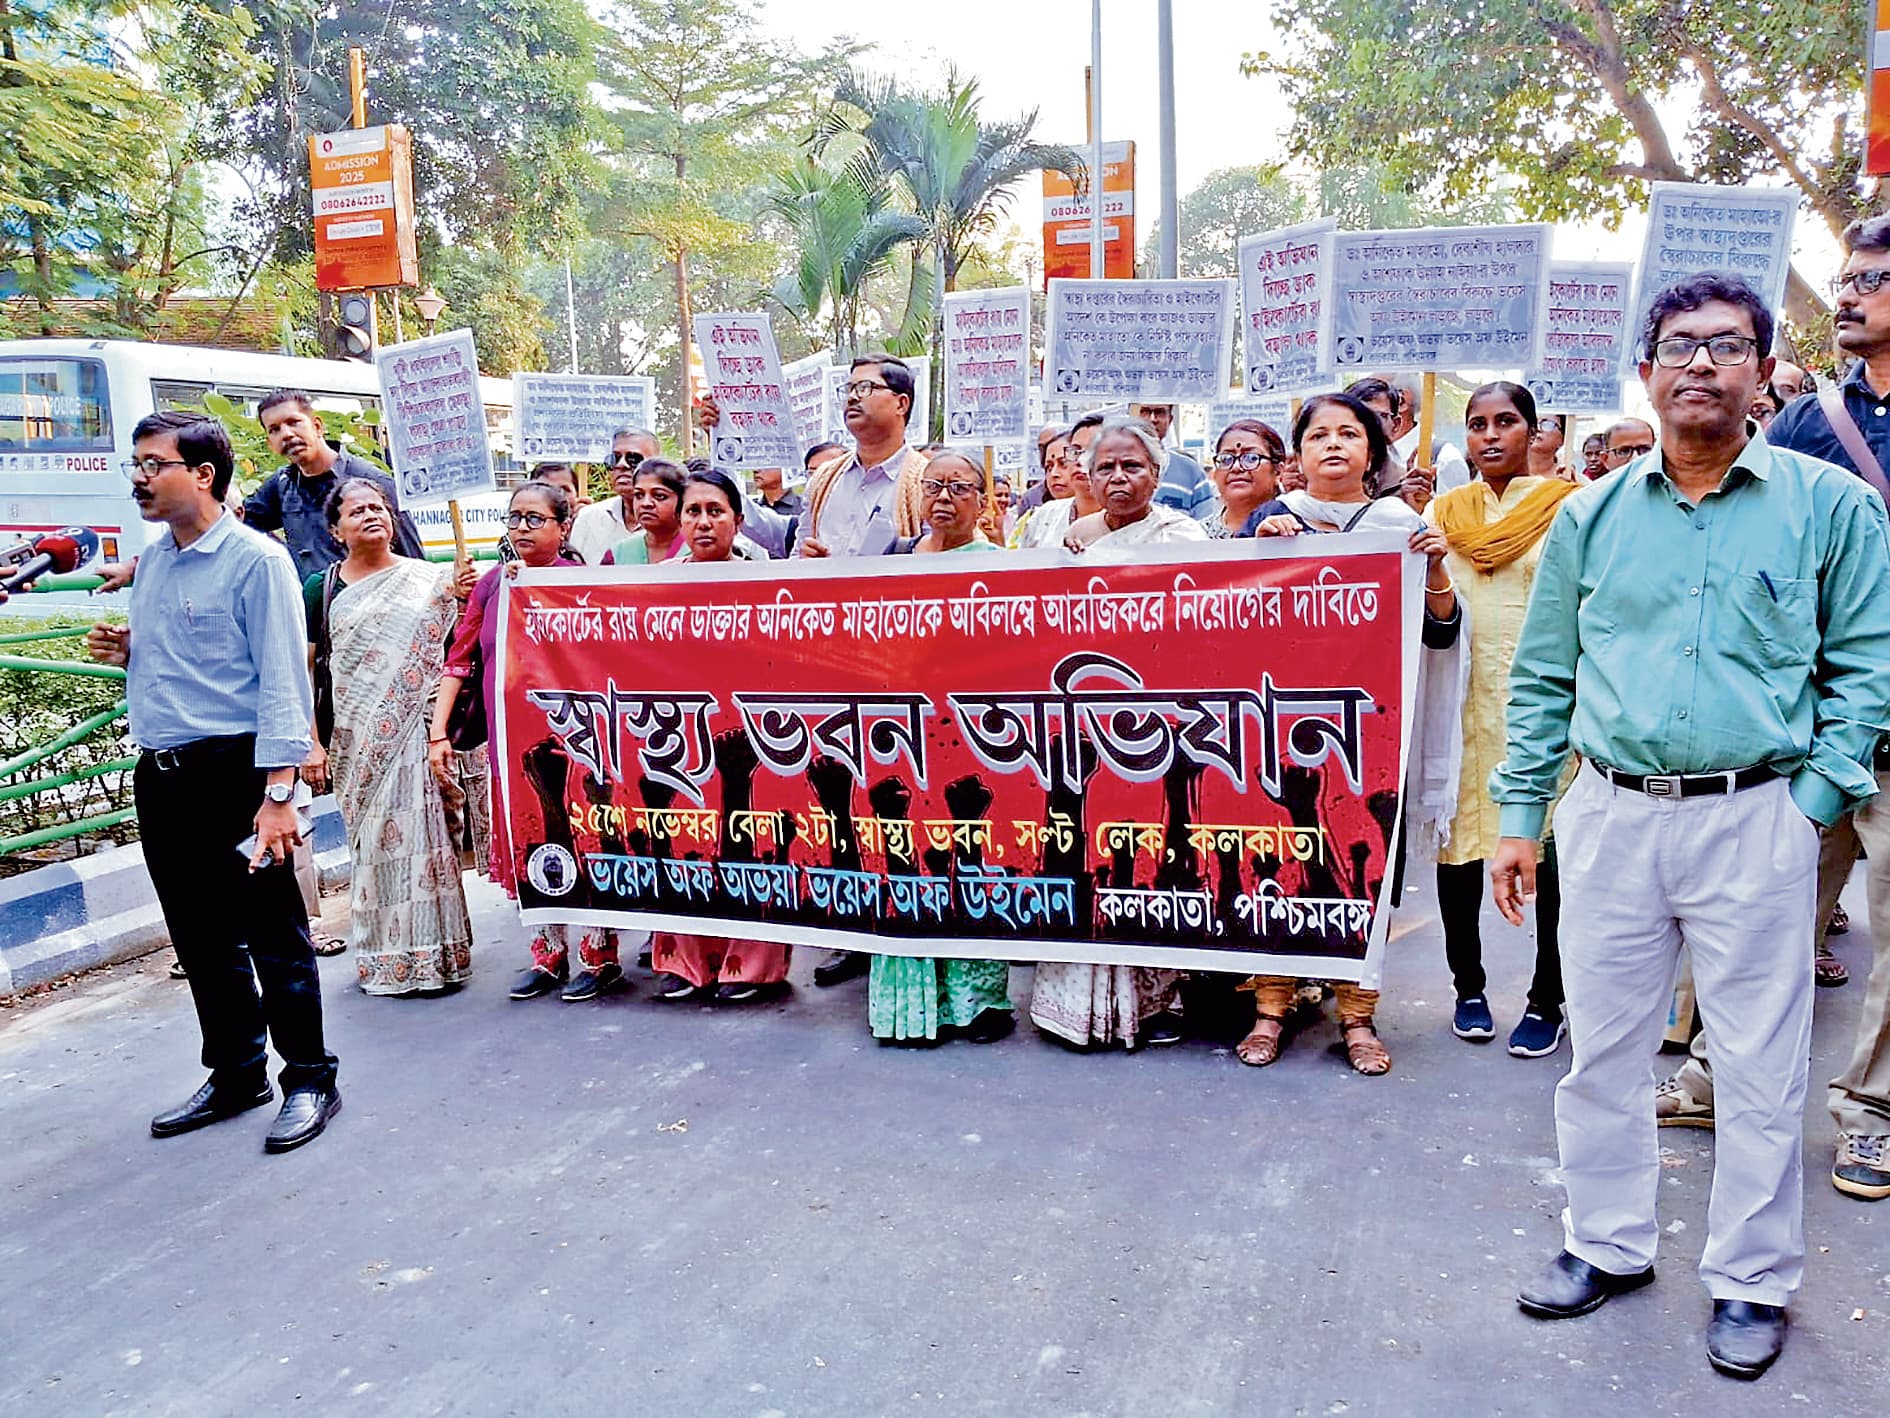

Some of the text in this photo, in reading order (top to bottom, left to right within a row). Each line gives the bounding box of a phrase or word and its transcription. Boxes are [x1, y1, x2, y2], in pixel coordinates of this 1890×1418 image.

[324, 155, 379, 172] ADMISSION
[340, 170, 365, 184] 2025
[321, 194, 386, 211] 08062642222
[1051, 202, 1123, 217] 080626222
[66, 457, 108, 472] POLICE
[466, 509, 485, 523] CITY
[607, 602, 639, 641] রায়
[644, 604, 686, 641] মেনে
[690, 601, 752, 641] ডাক্তার
[756, 589, 837, 641] অনিকেত
[842, 595, 946, 643] মাহাতোকে
[948, 581, 1036, 638] অবিলম্বে
[1042, 576, 1166, 635] আরজিকরে
[1172, 573, 1283, 633] নিয়োগের
[1290, 566, 1380, 627] দাবিতে
[527, 651, 1376, 806] স্বাস্থ্য ভবন অভিযান
[569, 802, 1328, 866] ২৫শে নভেম্বর বেলা ২টা, স্বাস্থ্য ভবন, সল্ট লেক, কলকাতা
[584, 852, 1373, 945] ভয়েস অফ অভয়া ভয়েস অফ উইমেন কলকাতা, পশ্চিমবঙ্গ
